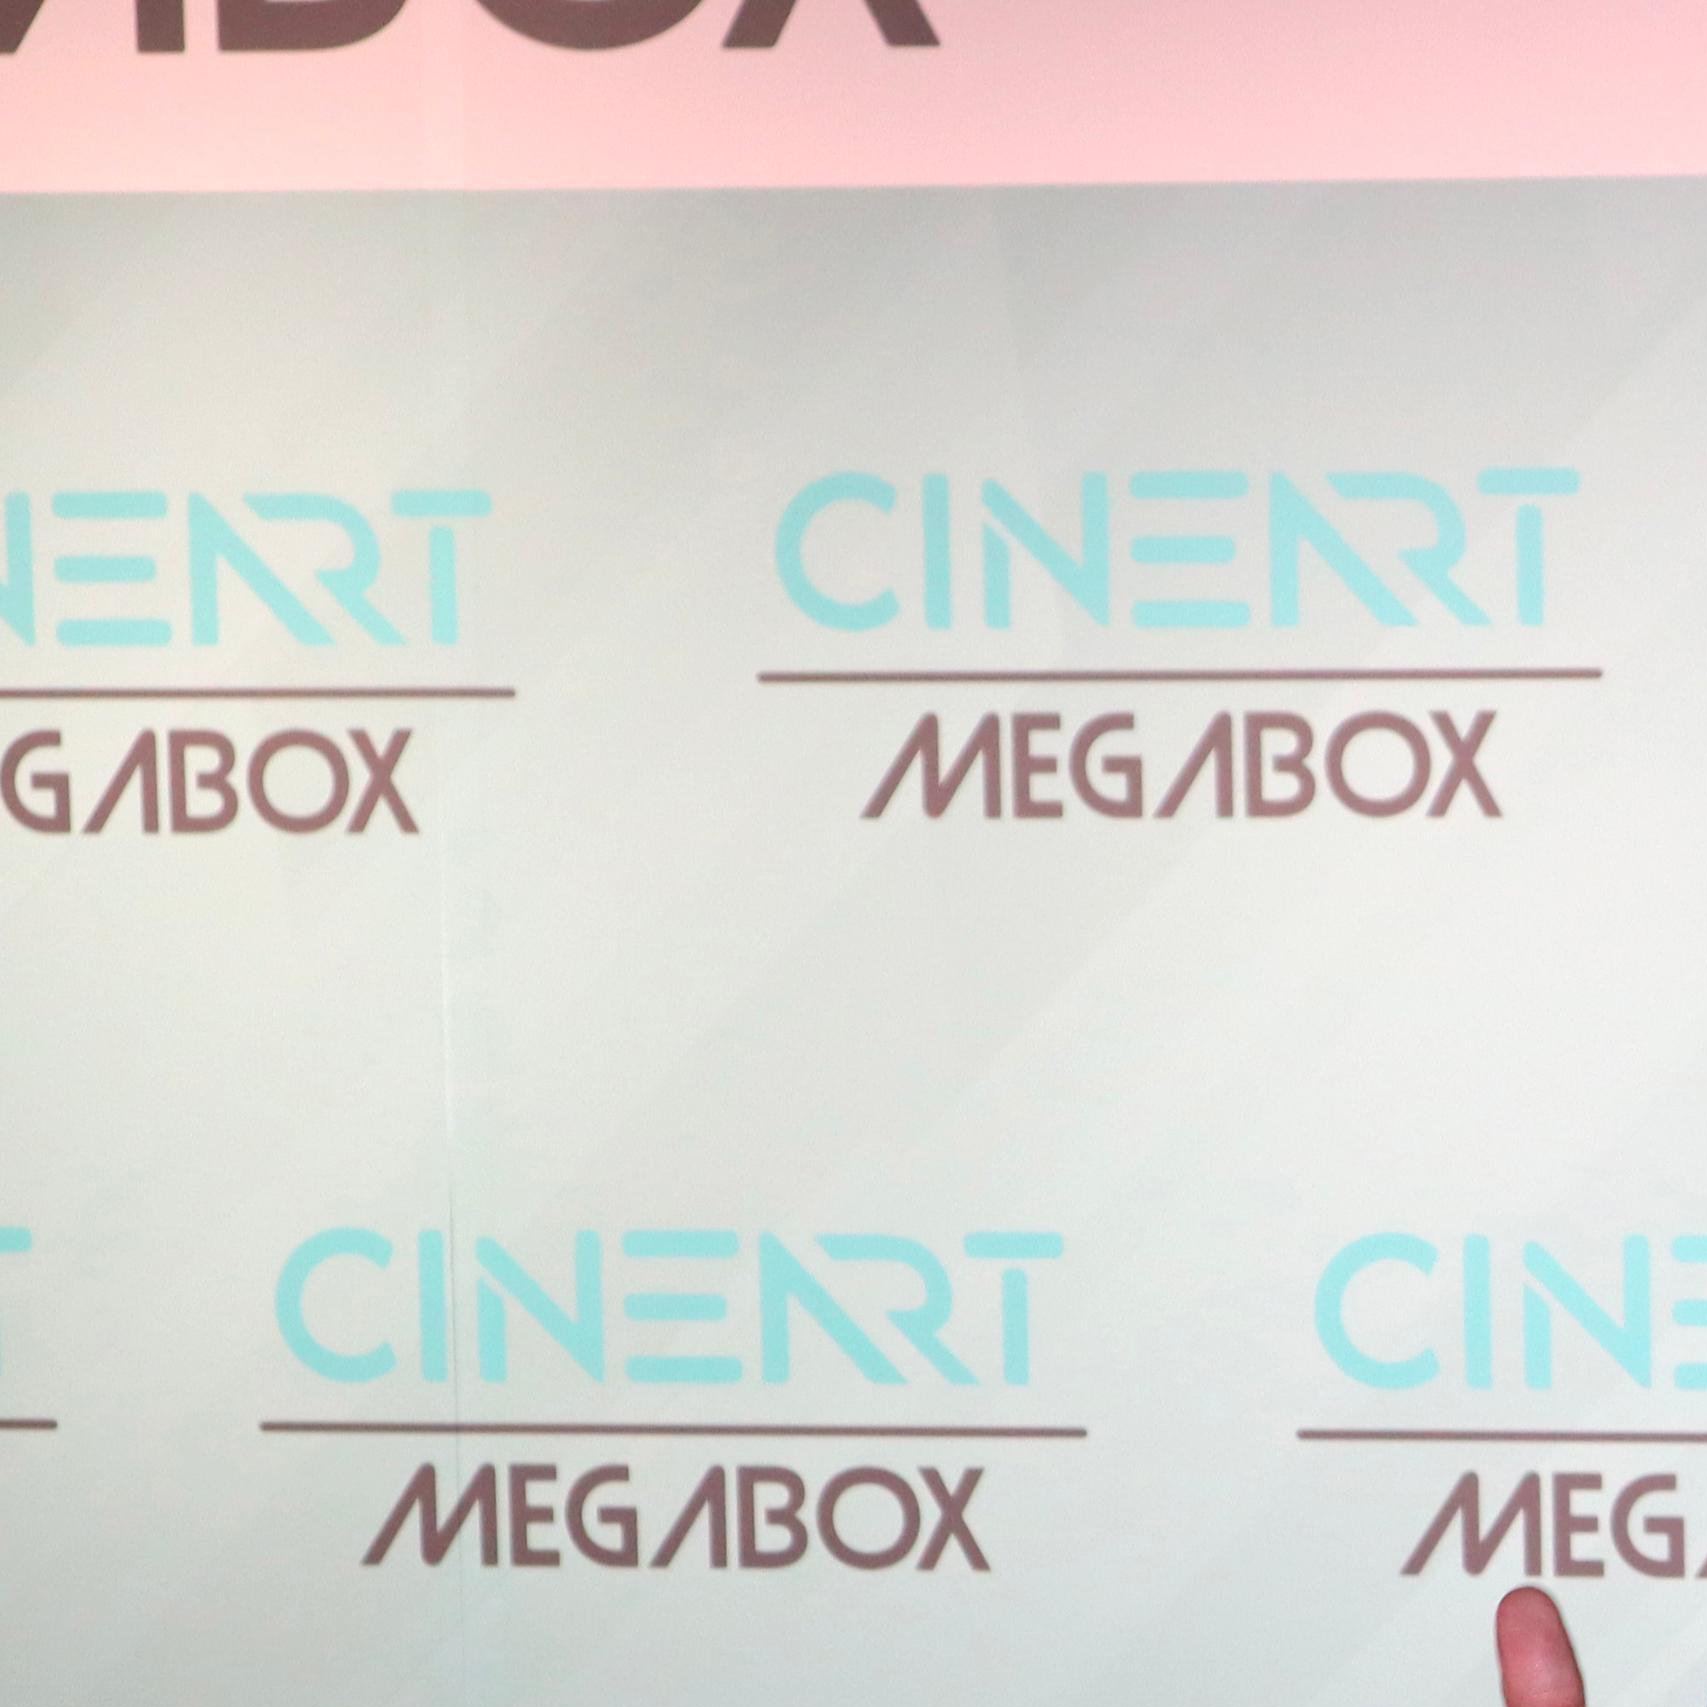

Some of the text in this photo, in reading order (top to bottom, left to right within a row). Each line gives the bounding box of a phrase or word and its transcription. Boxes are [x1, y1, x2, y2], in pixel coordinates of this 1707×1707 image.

[775, 467, 1581, 632] CINEART
[860, 710, 1504, 820] MEGABOX
[275, 1226, 1065, 1387] CINEART
[361, 1462, 991, 1572] MEGABOX
